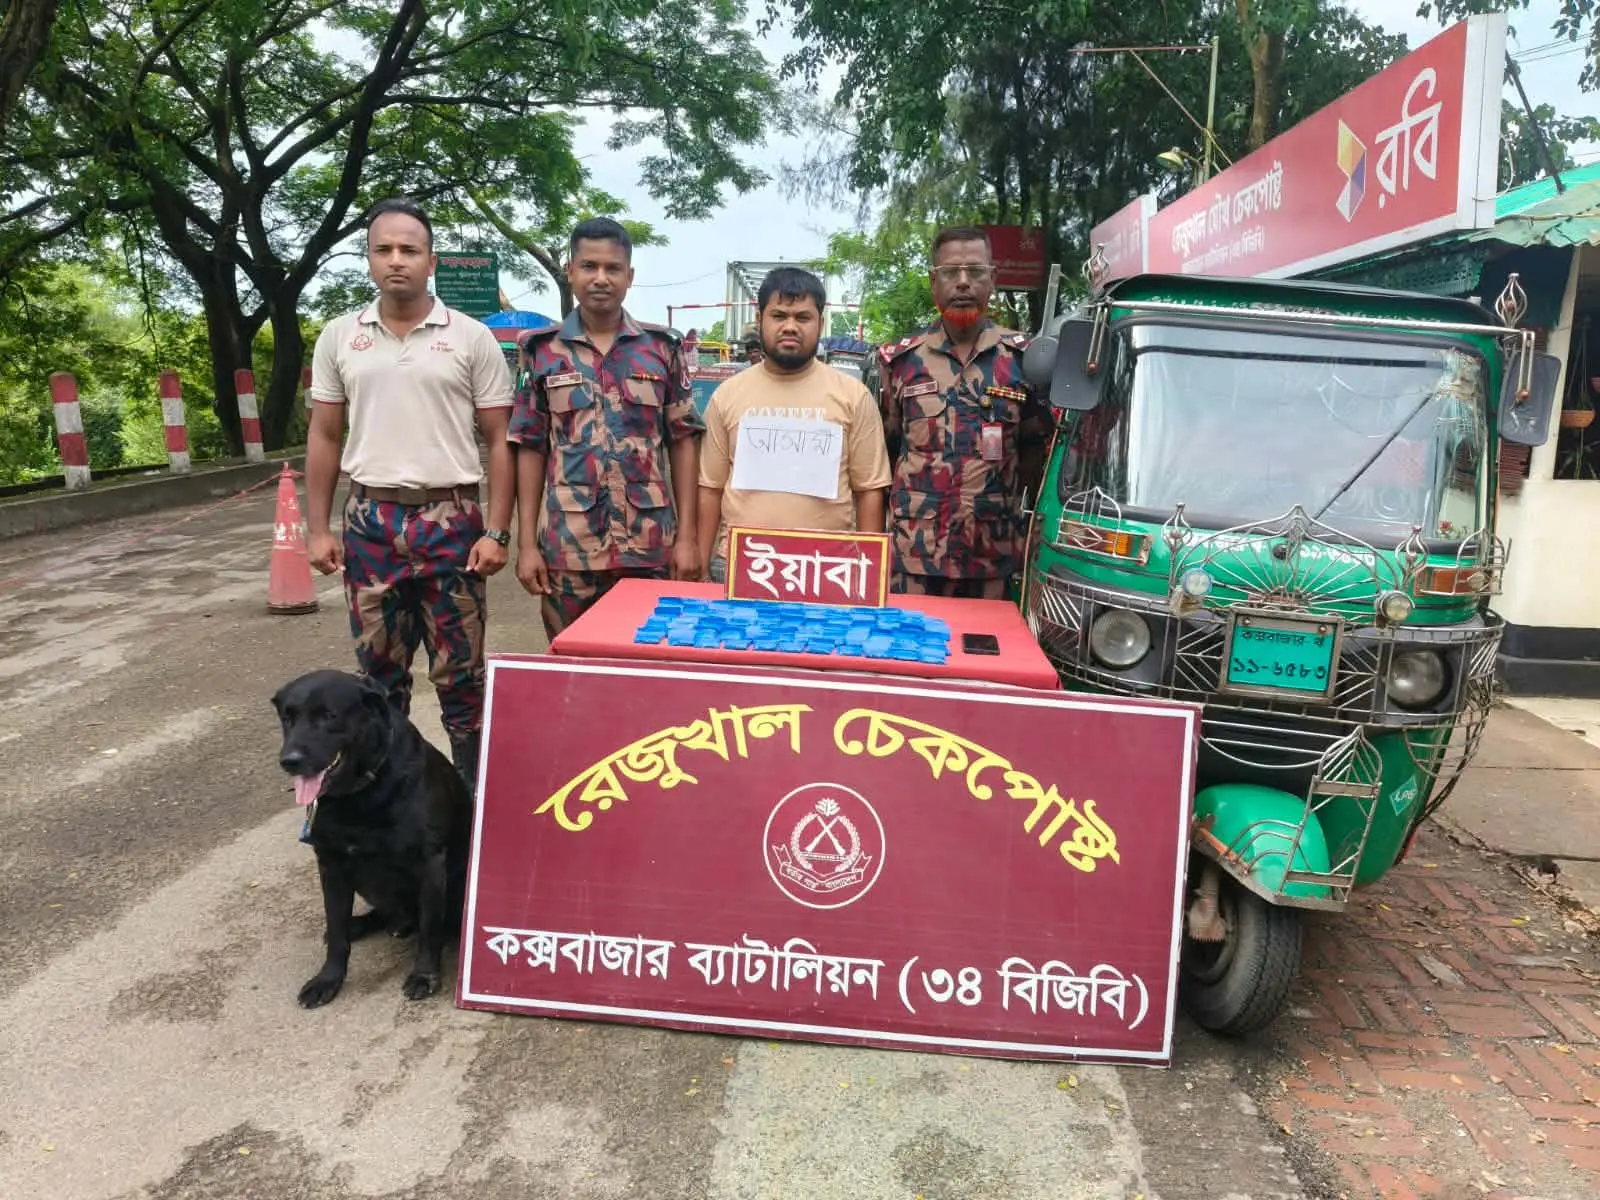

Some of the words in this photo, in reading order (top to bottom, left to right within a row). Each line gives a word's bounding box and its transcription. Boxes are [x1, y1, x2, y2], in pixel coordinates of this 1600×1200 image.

[1374, 67, 1443, 209] রবি
[743, 536, 873, 599] ইয়াবা
[1232, 657, 1327, 680] ১১-৬৫৮৩
[533, 703, 815, 832] রেজুখাল
[833, 707, 1121, 873] চেকপোষ্ট
[482, 926, 676, 980] কক্সবাজার
[684, 933, 885, 1001] ব্যাটালিয়ন
[898, 955, 983, 1014] (৩৪
[996, 956, 1149, 1030] বিজিবি)
